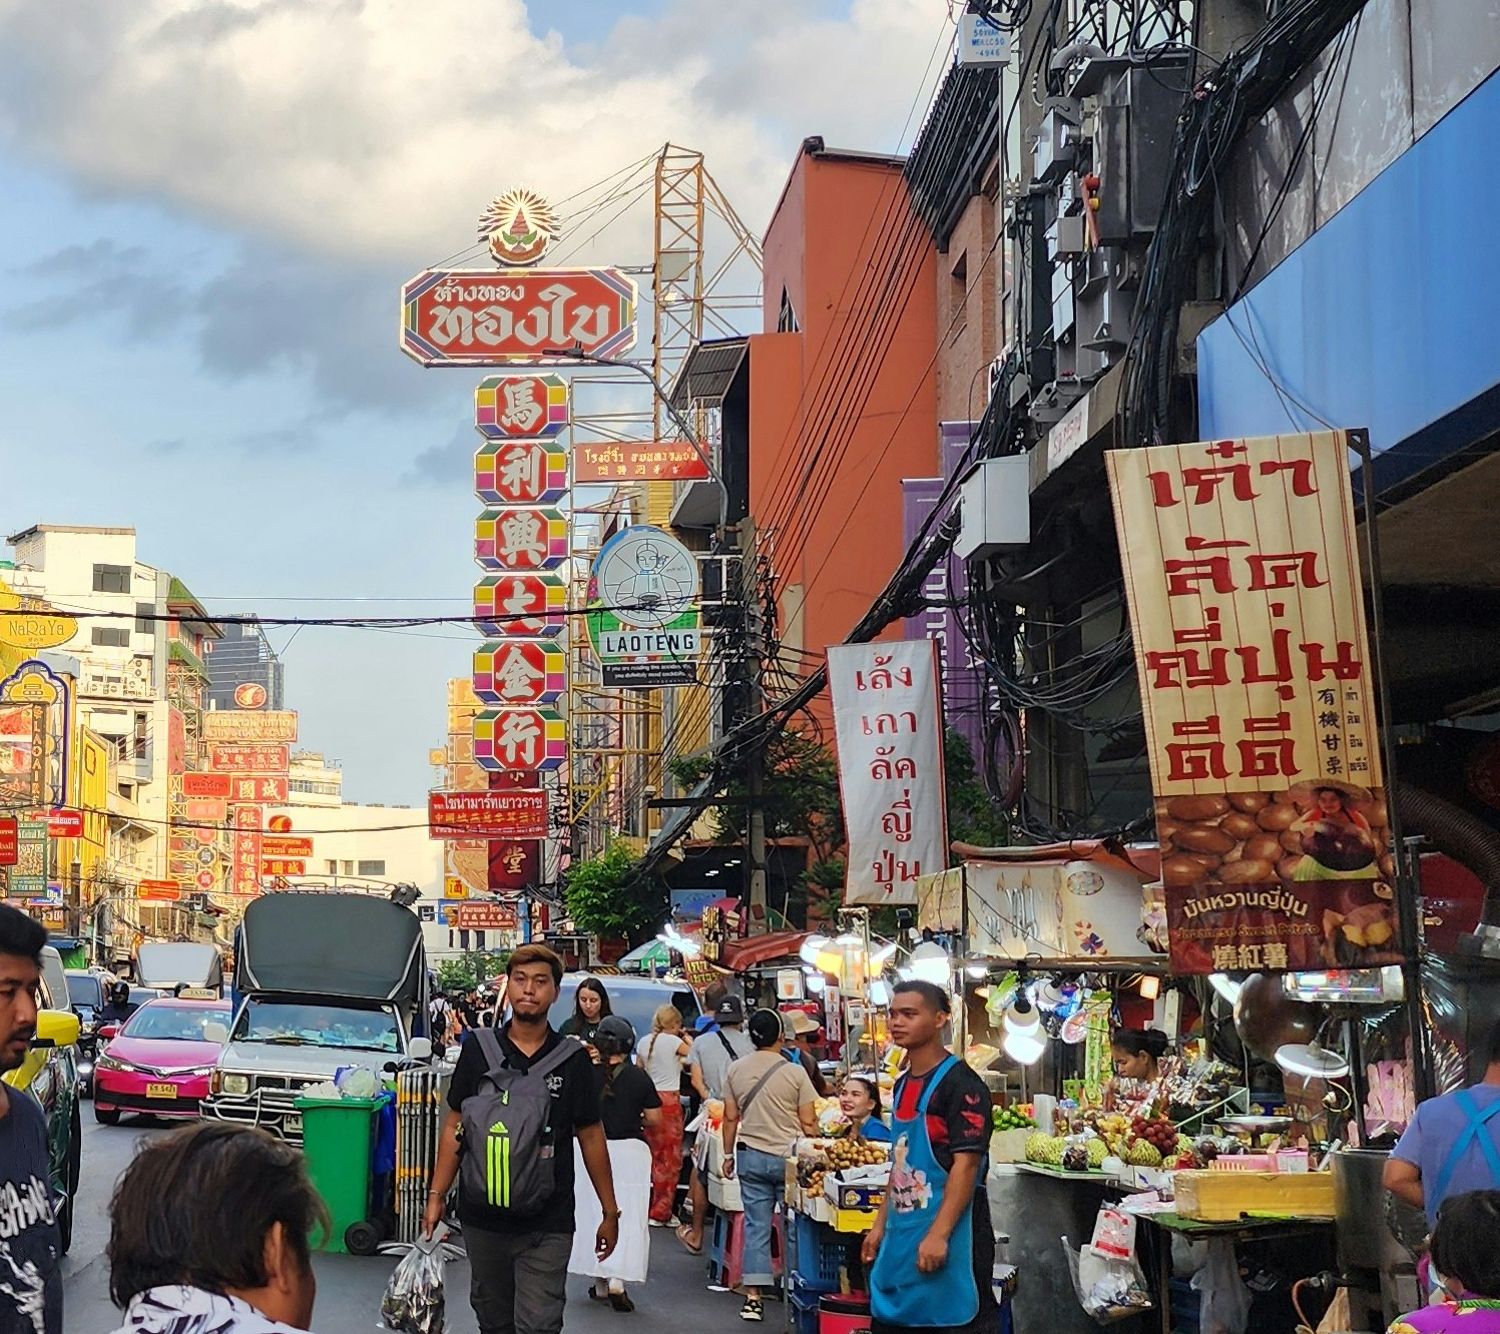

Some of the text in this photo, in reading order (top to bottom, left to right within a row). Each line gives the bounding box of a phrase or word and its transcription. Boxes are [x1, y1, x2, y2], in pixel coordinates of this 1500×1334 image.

[434, 279, 525, 303] ห้างทอง
[429, 283, 612, 346] ทองใบ
[9, 620, 64, 635] NaRaYa
[607, 634, 694, 653] LAOTENG
[862, 711, 917, 736] เกา
[503, 845, 527, 874] 堂
[1183, 886, 1308, 918] มันหวานญี่ปุ่น
